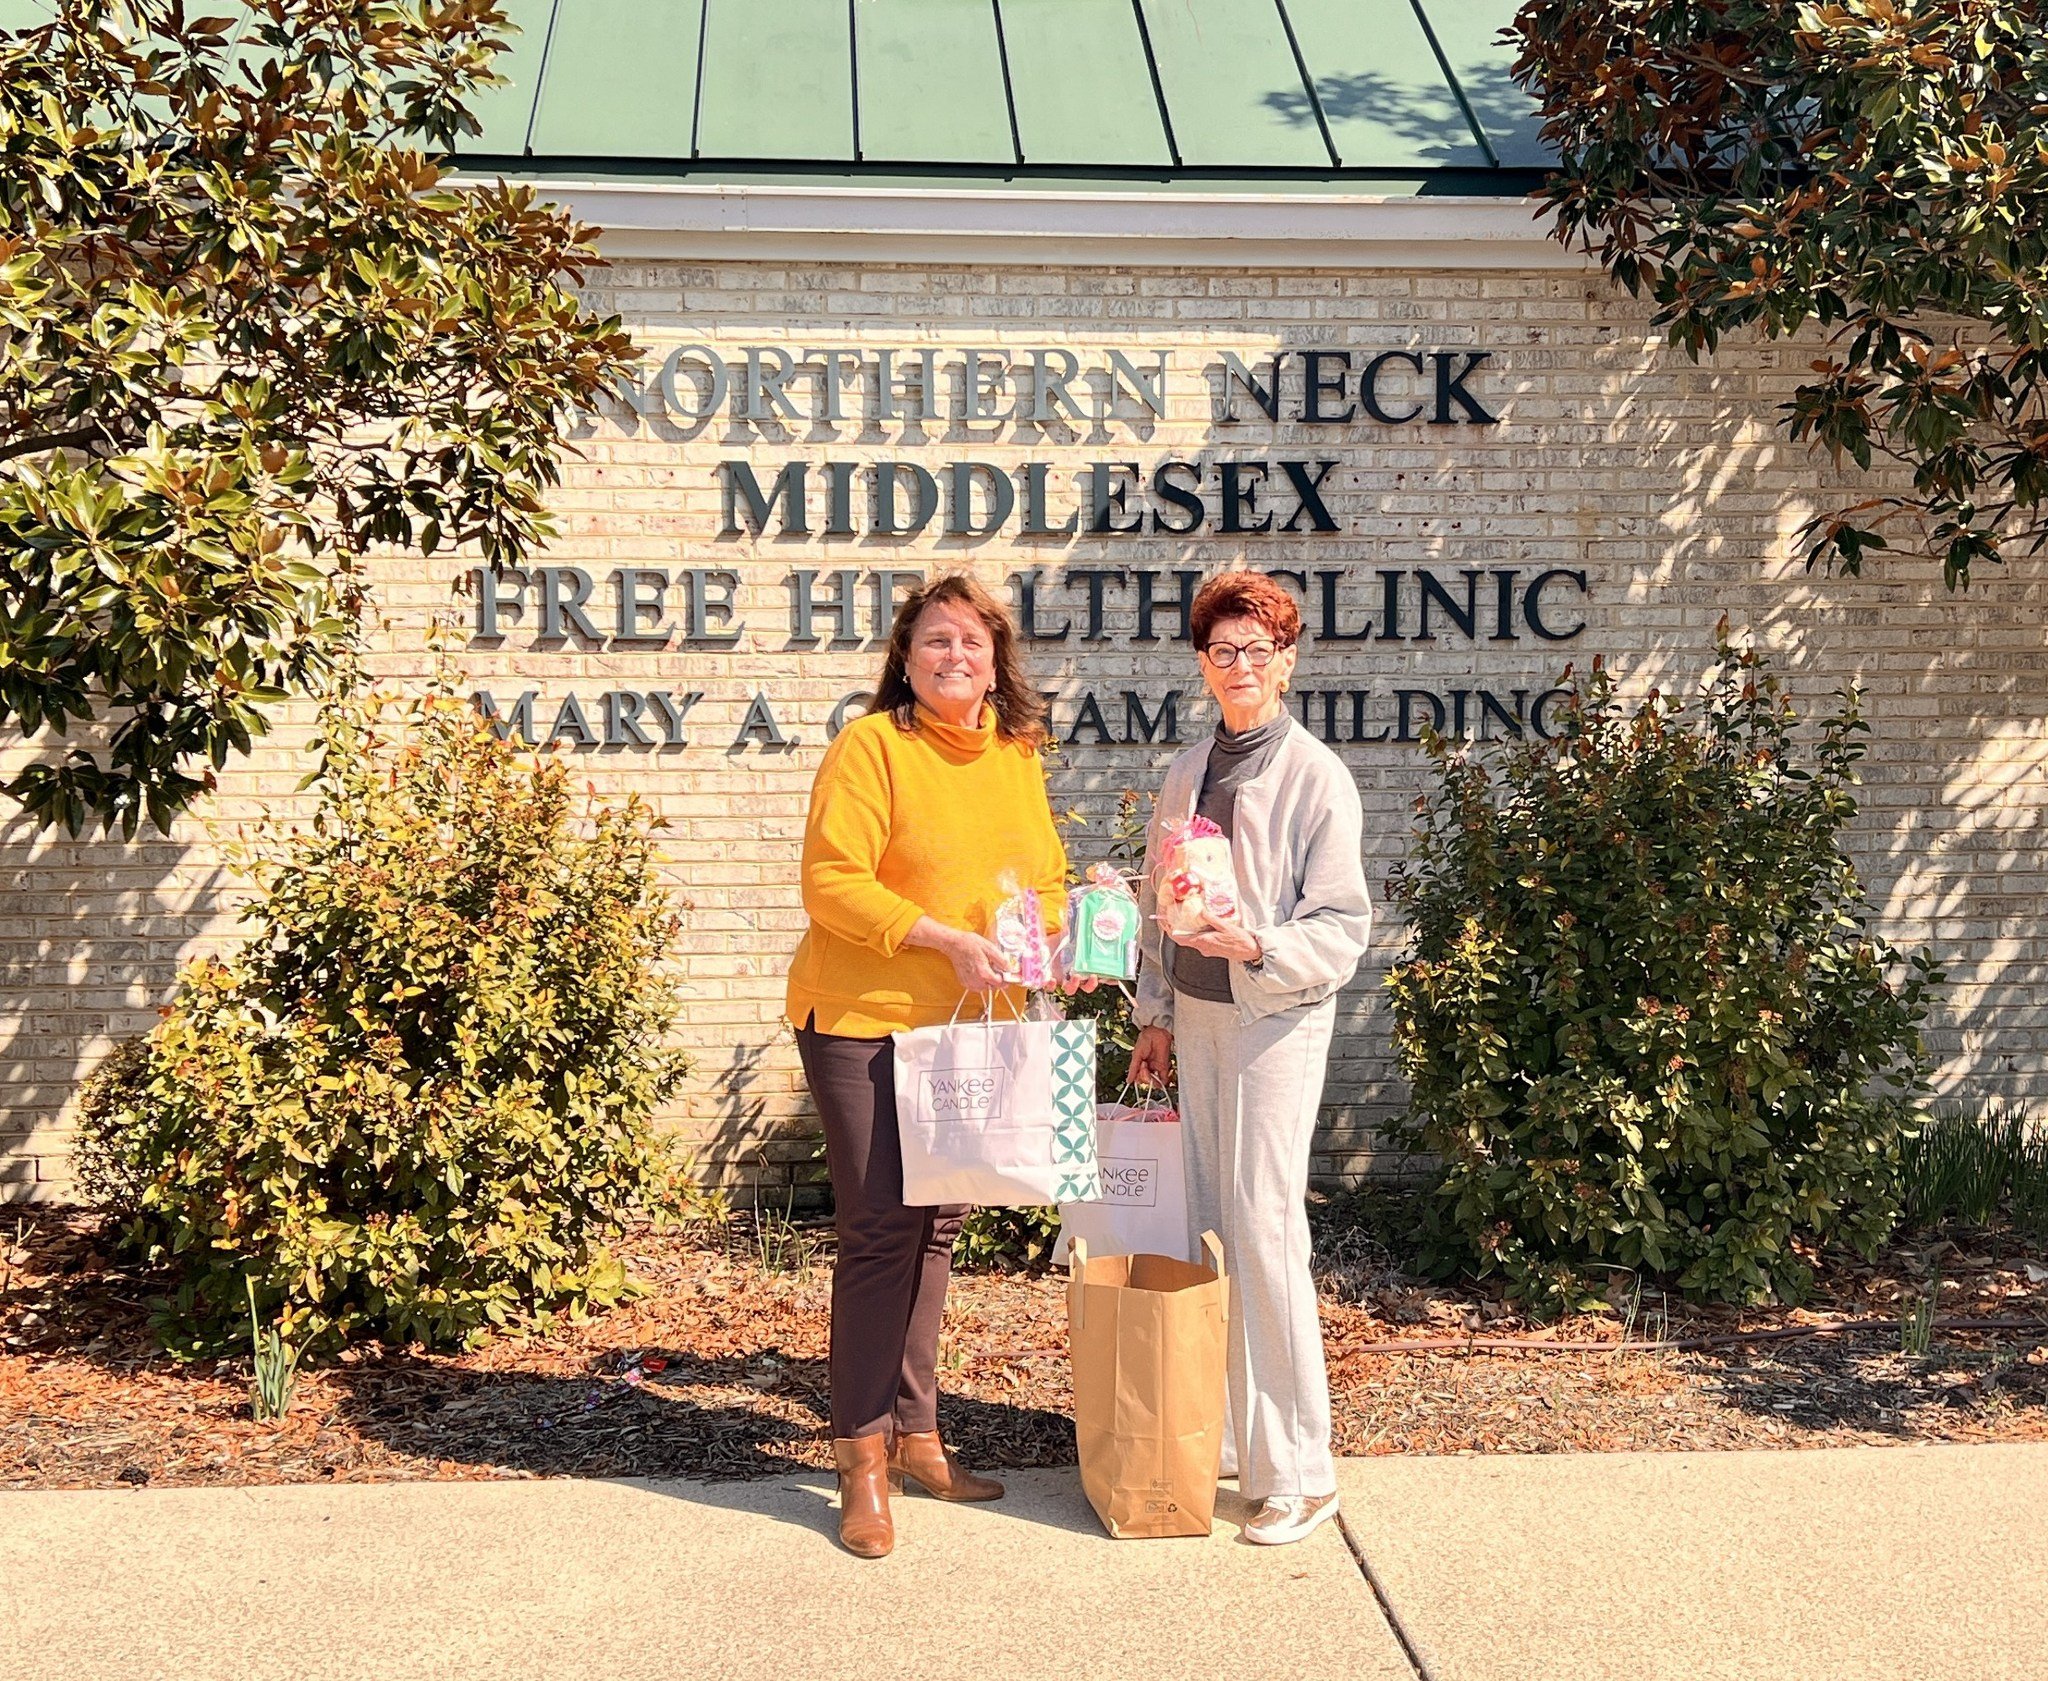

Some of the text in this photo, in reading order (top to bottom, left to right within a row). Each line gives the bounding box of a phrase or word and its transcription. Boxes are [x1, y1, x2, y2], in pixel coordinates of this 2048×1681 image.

[1215, 350, 1500, 425] NECK
[720, 460, 1342, 534] MIDDLESEX
[474, 565, 746, 643] FREE
[789, 568, 1203, 643] HELTH
[472, 690, 704, 745] MARY
[737, 690, 801, 747] A.
